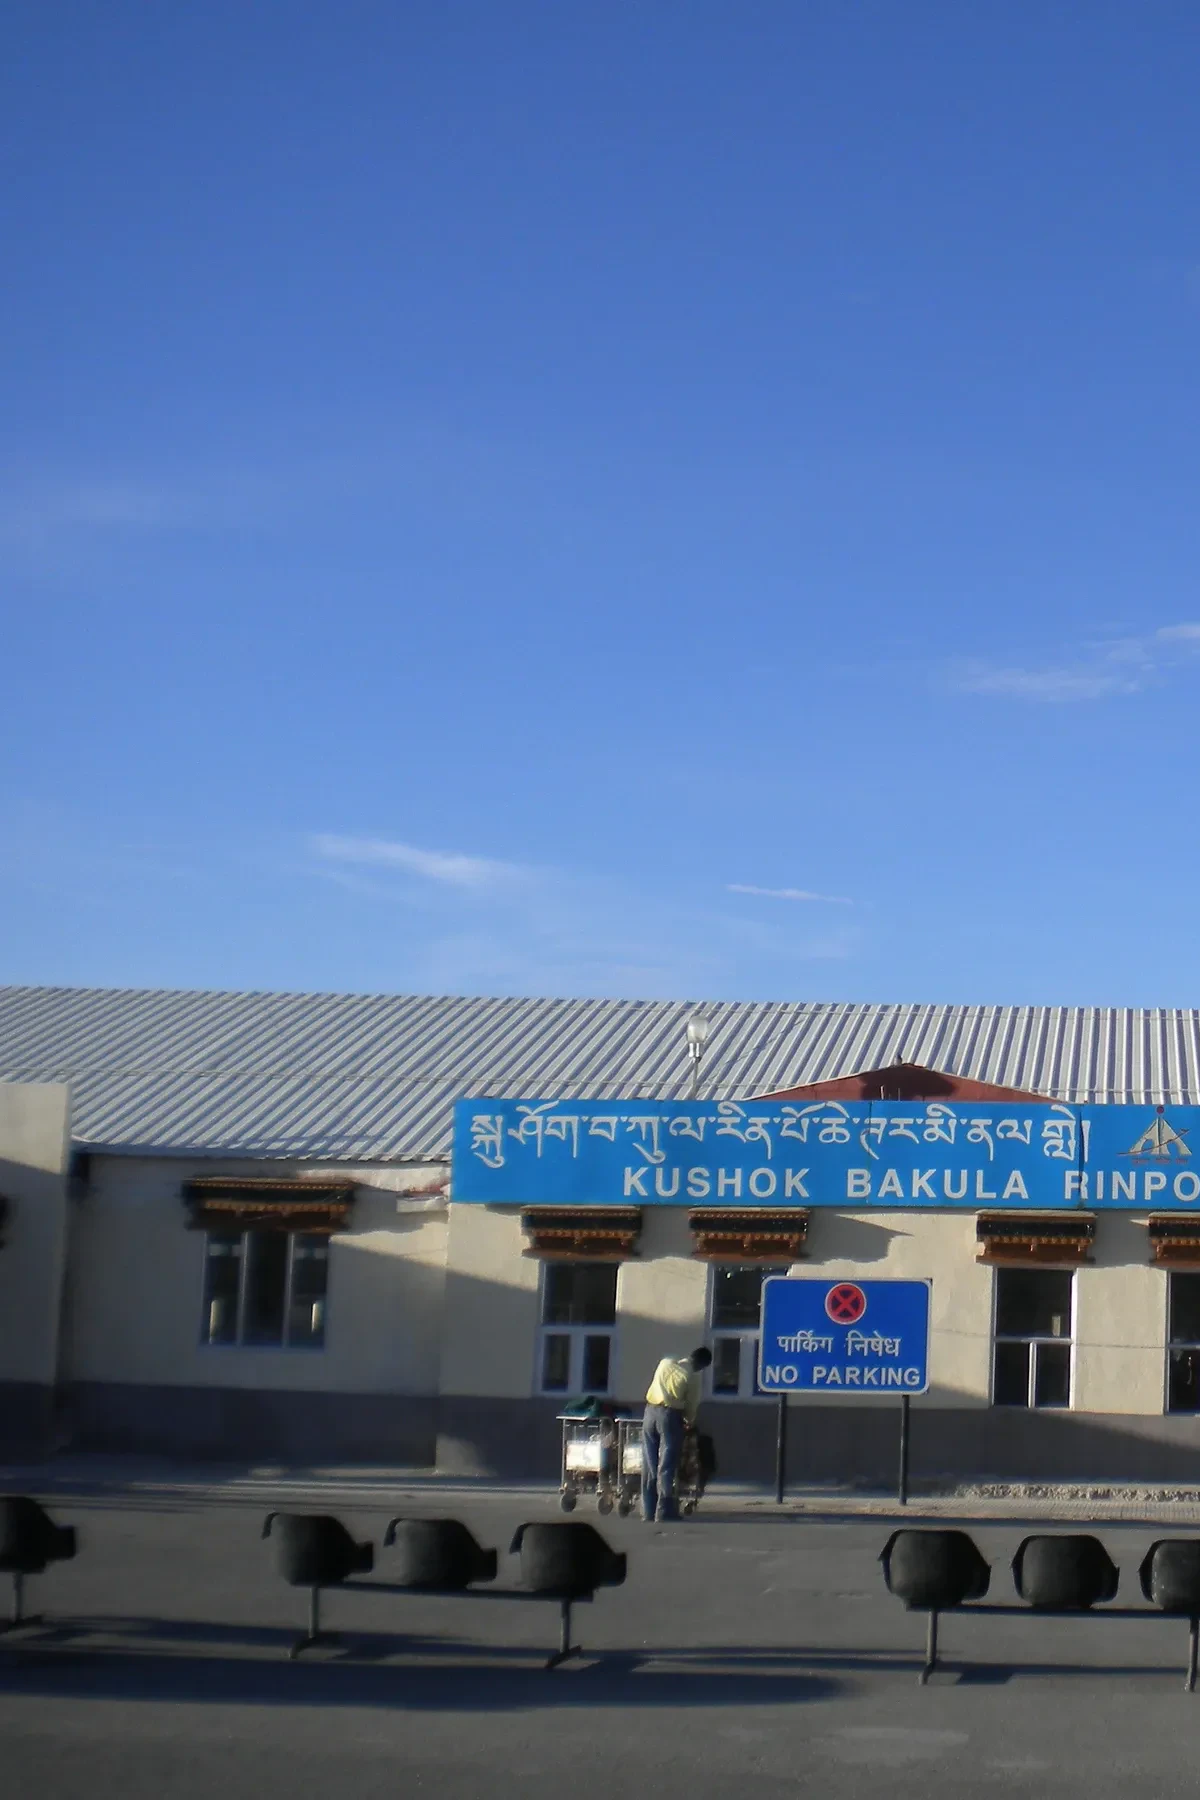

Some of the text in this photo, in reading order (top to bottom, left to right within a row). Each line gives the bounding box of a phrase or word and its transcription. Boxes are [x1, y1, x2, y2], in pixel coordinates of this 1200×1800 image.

[622, 1166, 810, 1199] KUSHOK
[846, 1168, 1030, 1200] BAKULA
[845, 1329, 902, 1358] निषेध
[764, 1365, 922, 1387] NO PARKING
